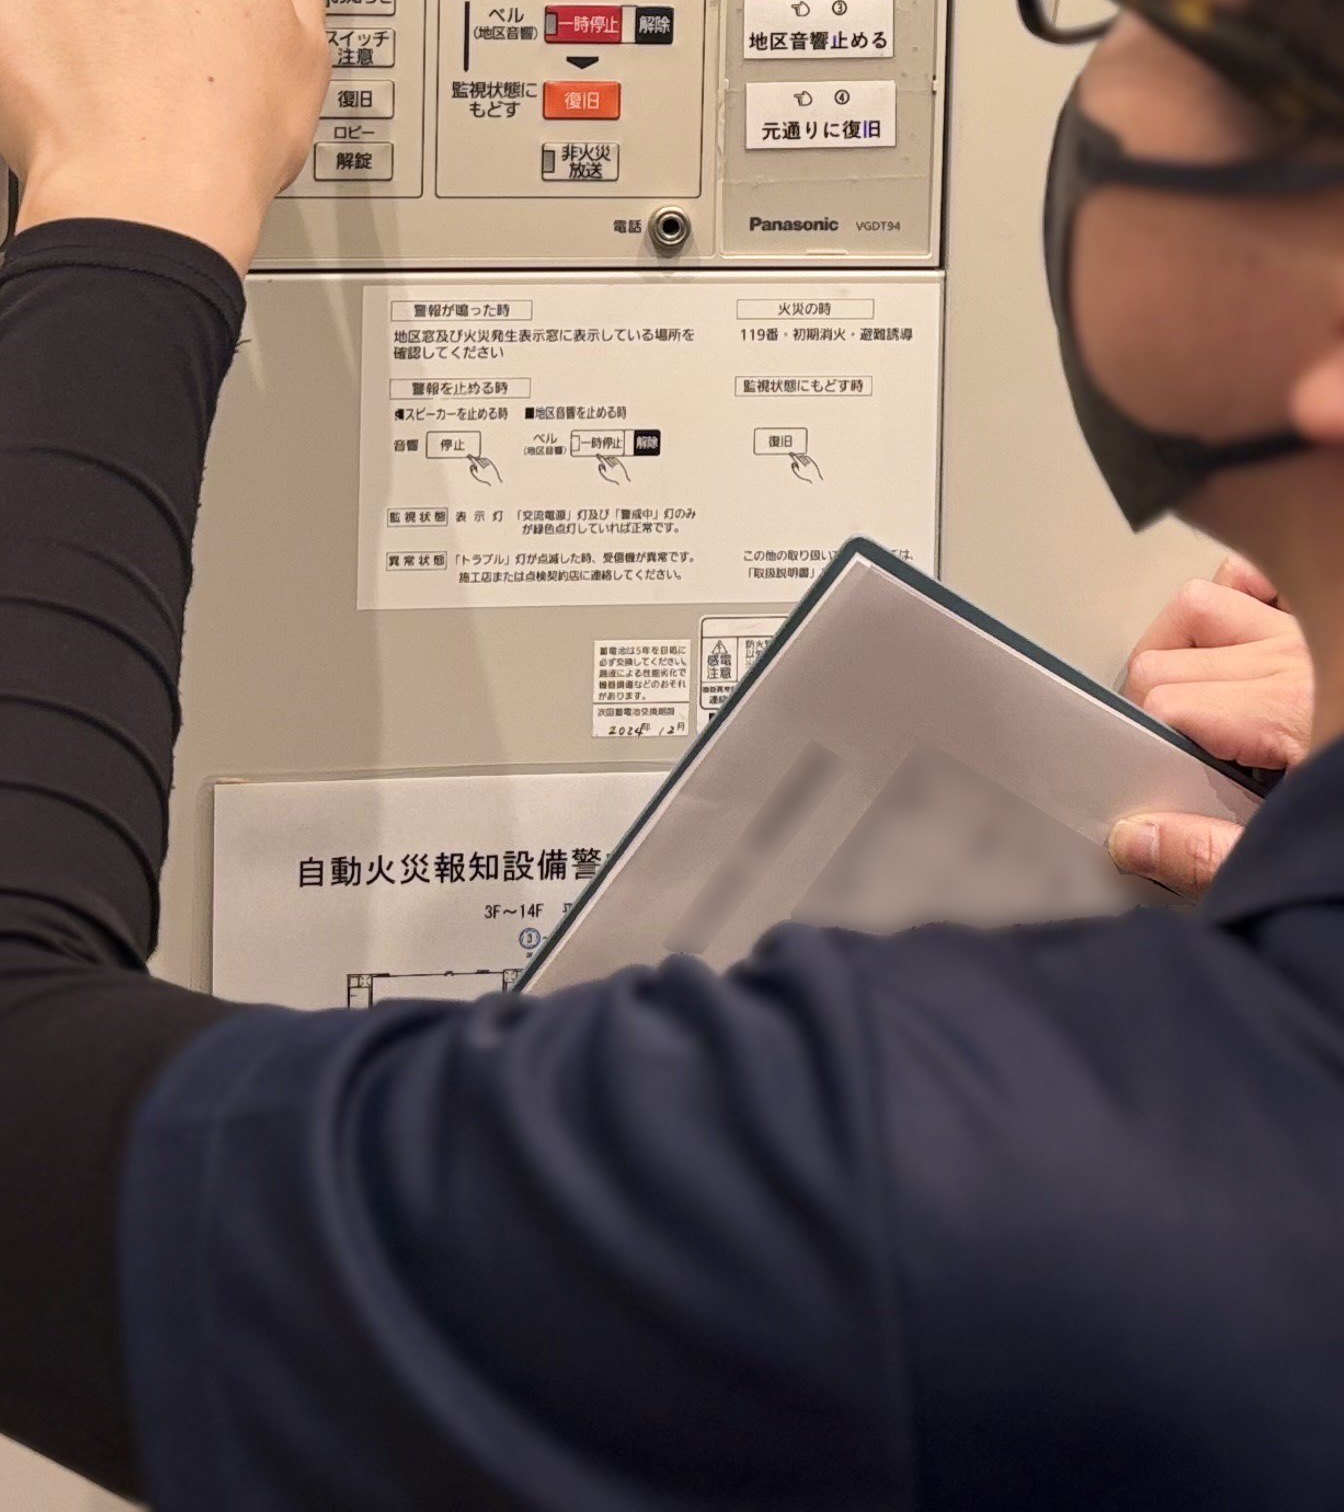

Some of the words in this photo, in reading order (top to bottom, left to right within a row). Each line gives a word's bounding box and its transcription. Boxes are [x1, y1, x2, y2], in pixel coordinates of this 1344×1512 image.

[488, 7, 524, 24] ベル
[558, 15, 619, 34] 一時停止
[639, 15, 671, 35] 解除
[328, 30, 389, 47] スイッチ
[473, 26, 538, 42] (地区音響)
[749, 31, 888, 52] 地区音響止める
[338, 48, 374, 66] 注意
[451, 81, 538, 99] 監視状態に
[337, 90, 373, 108] 復旧
[564, 91, 600, 110] 復旧
[470, 101, 521, 118] もどす
[333, 125, 375, 139] ロビー
[762, 120, 881, 140] 元通りに復旧
[561, 144, 611, 162] 非火災
[336, 153, 372, 171] 解錠
[569, 162, 603, 180] 放送
[613, 219, 642, 234] 電話
[750, 216, 839, 231] Panasonic
[414, 303, 510, 318] 警報が鳴った時
[778, 302, 831, 316] 火災の時
[394, 345, 504, 360] 確認してください
[412, 381, 508, 396] 警報を止める時
[743, 379, 864, 393] 監視状態にもどす時
[394, 439, 419, 452] 音響
[440, 439, 465, 452] 停止
[580, 437, 622, 450] 一時停止
[768, 435, 793, 448] 復旧
[298, 846, 613, 888] 自動火災報知設備警
